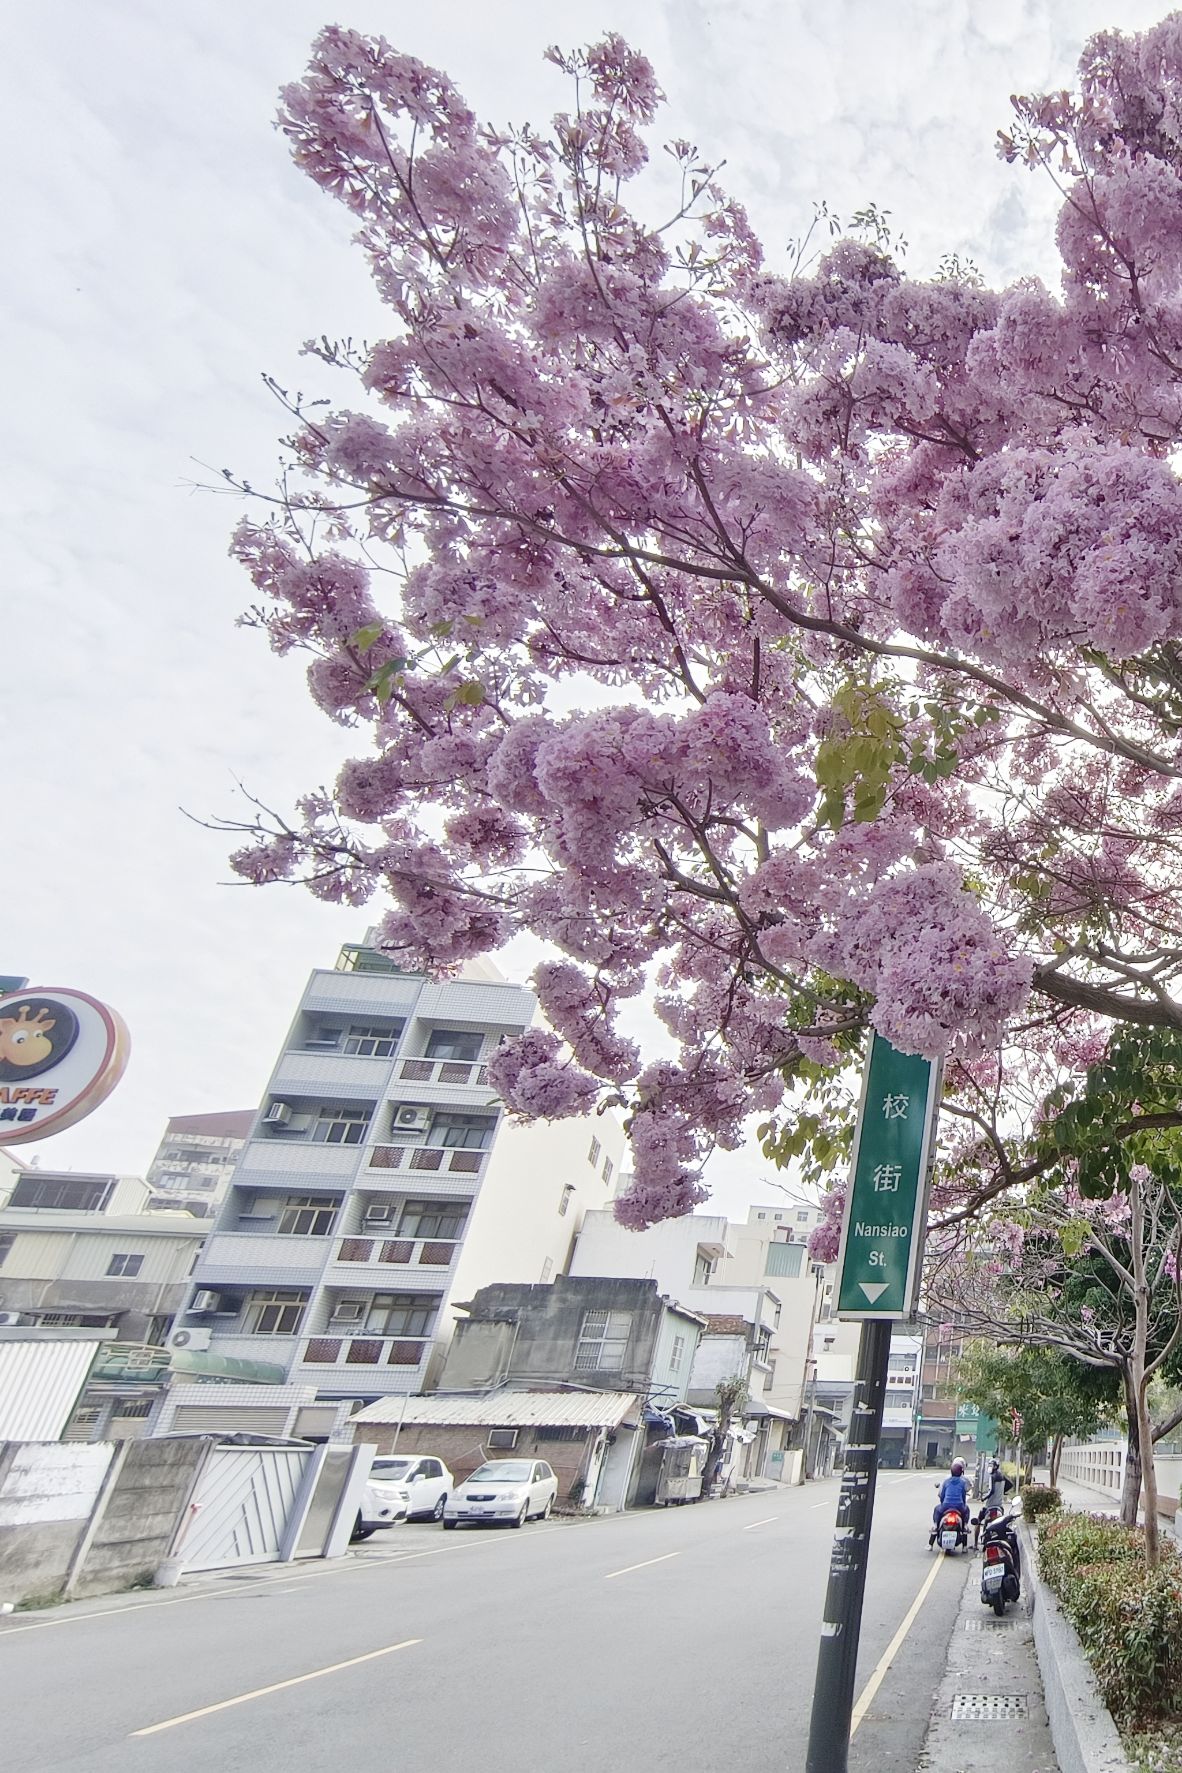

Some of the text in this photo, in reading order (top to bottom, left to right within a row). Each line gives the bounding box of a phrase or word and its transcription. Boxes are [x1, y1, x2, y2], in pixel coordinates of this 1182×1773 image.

[873, 1093, 910, 1193] 校街
[854, 1221, 908, 1238] Nansiao
[868, 1250, 887, 1267] St.
